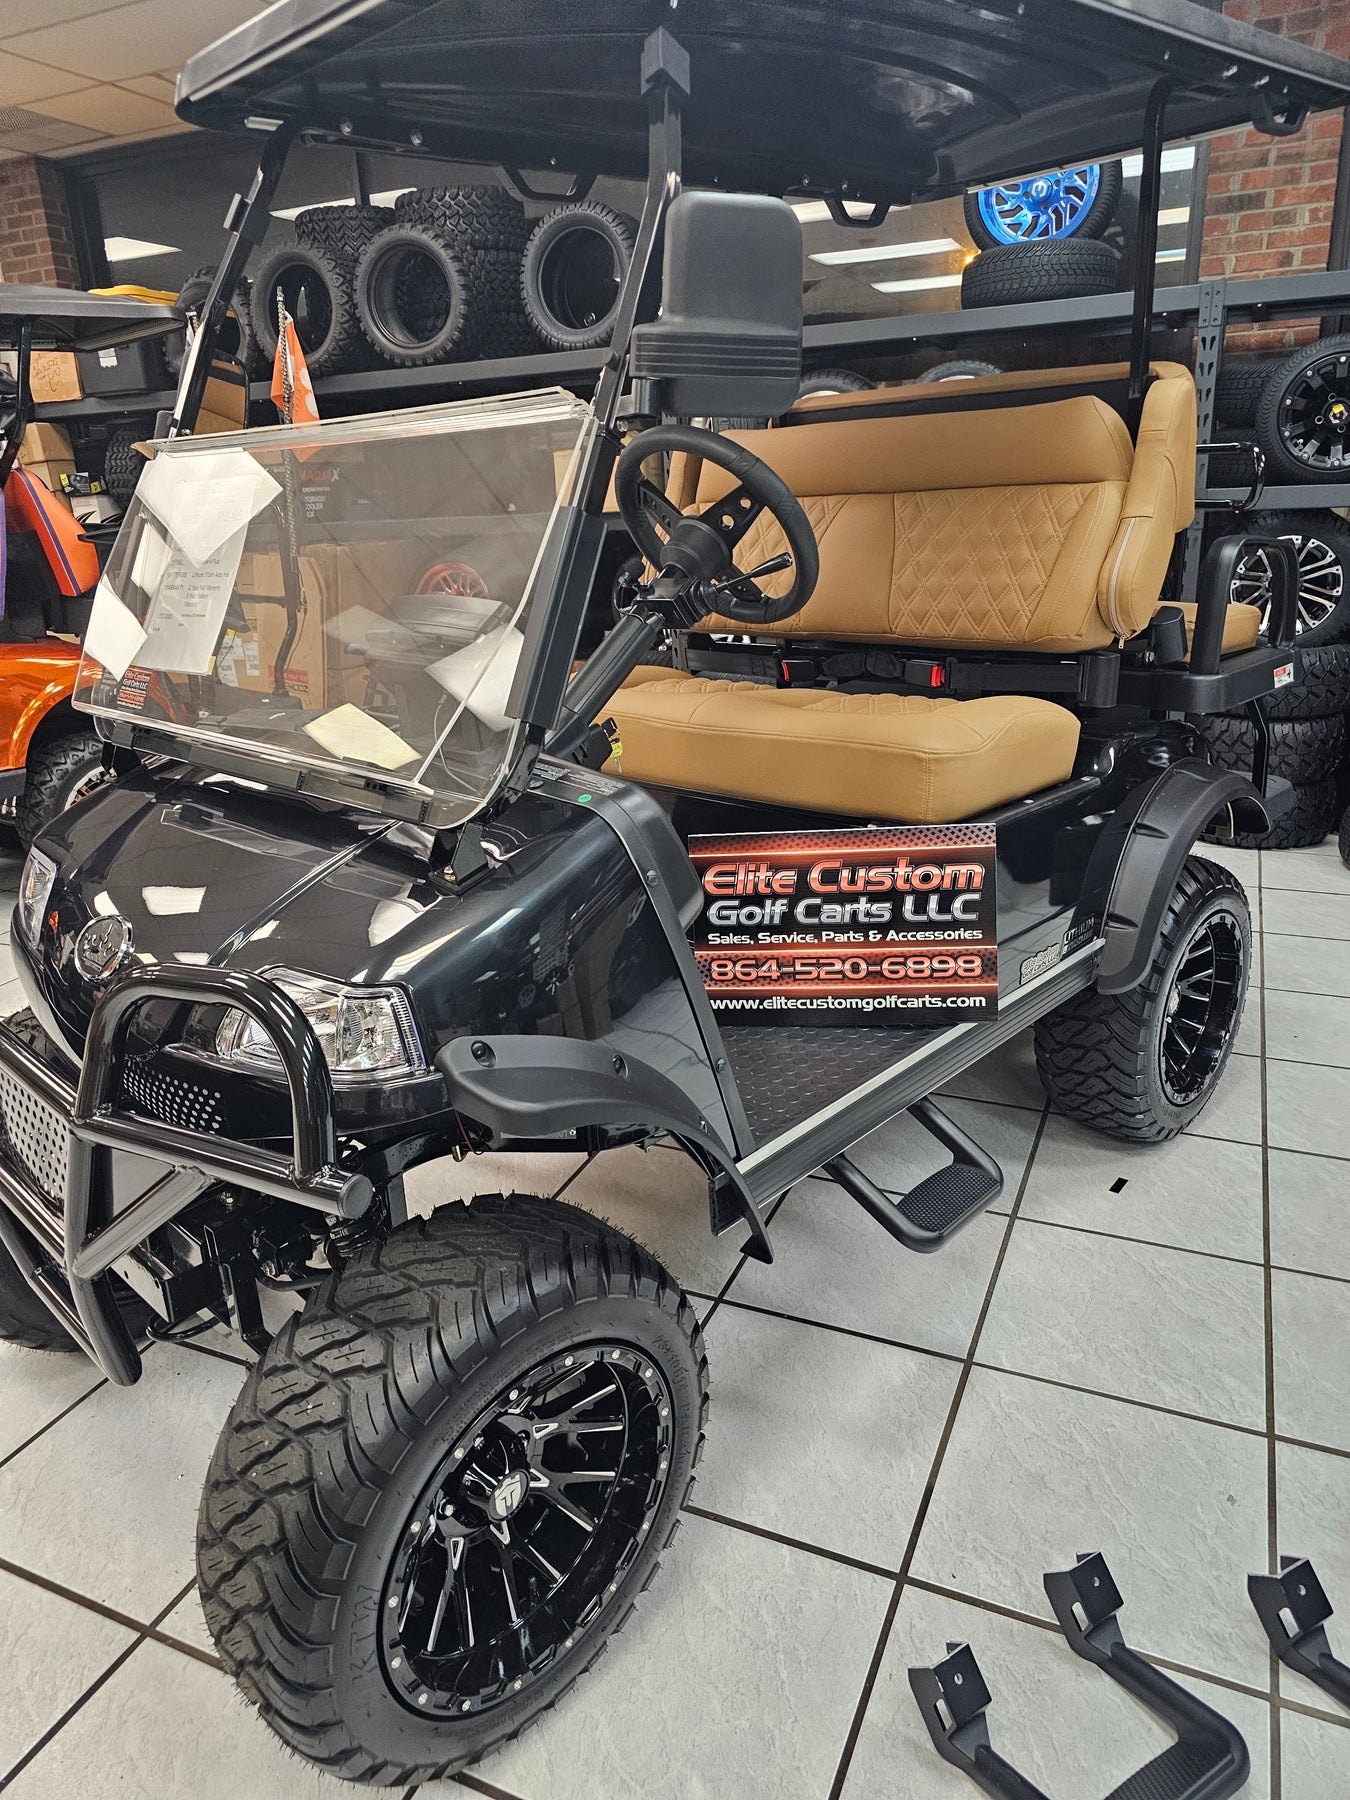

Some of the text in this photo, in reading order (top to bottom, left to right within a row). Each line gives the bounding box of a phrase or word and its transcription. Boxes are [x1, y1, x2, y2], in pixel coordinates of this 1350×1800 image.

[703, 857, 986, 896] Elite Custom
[706, 892, 982, 926] Golf Carts LLC
[707, 928, 983, 946] Sales, Service, Parts & Accessories
[1064, 916, 1095, 945] LITHIUM
[710, 954, 984, 982] 864-520-6898
[710, 994, 987, 1012] www.elitecustomgolfcarts.com
